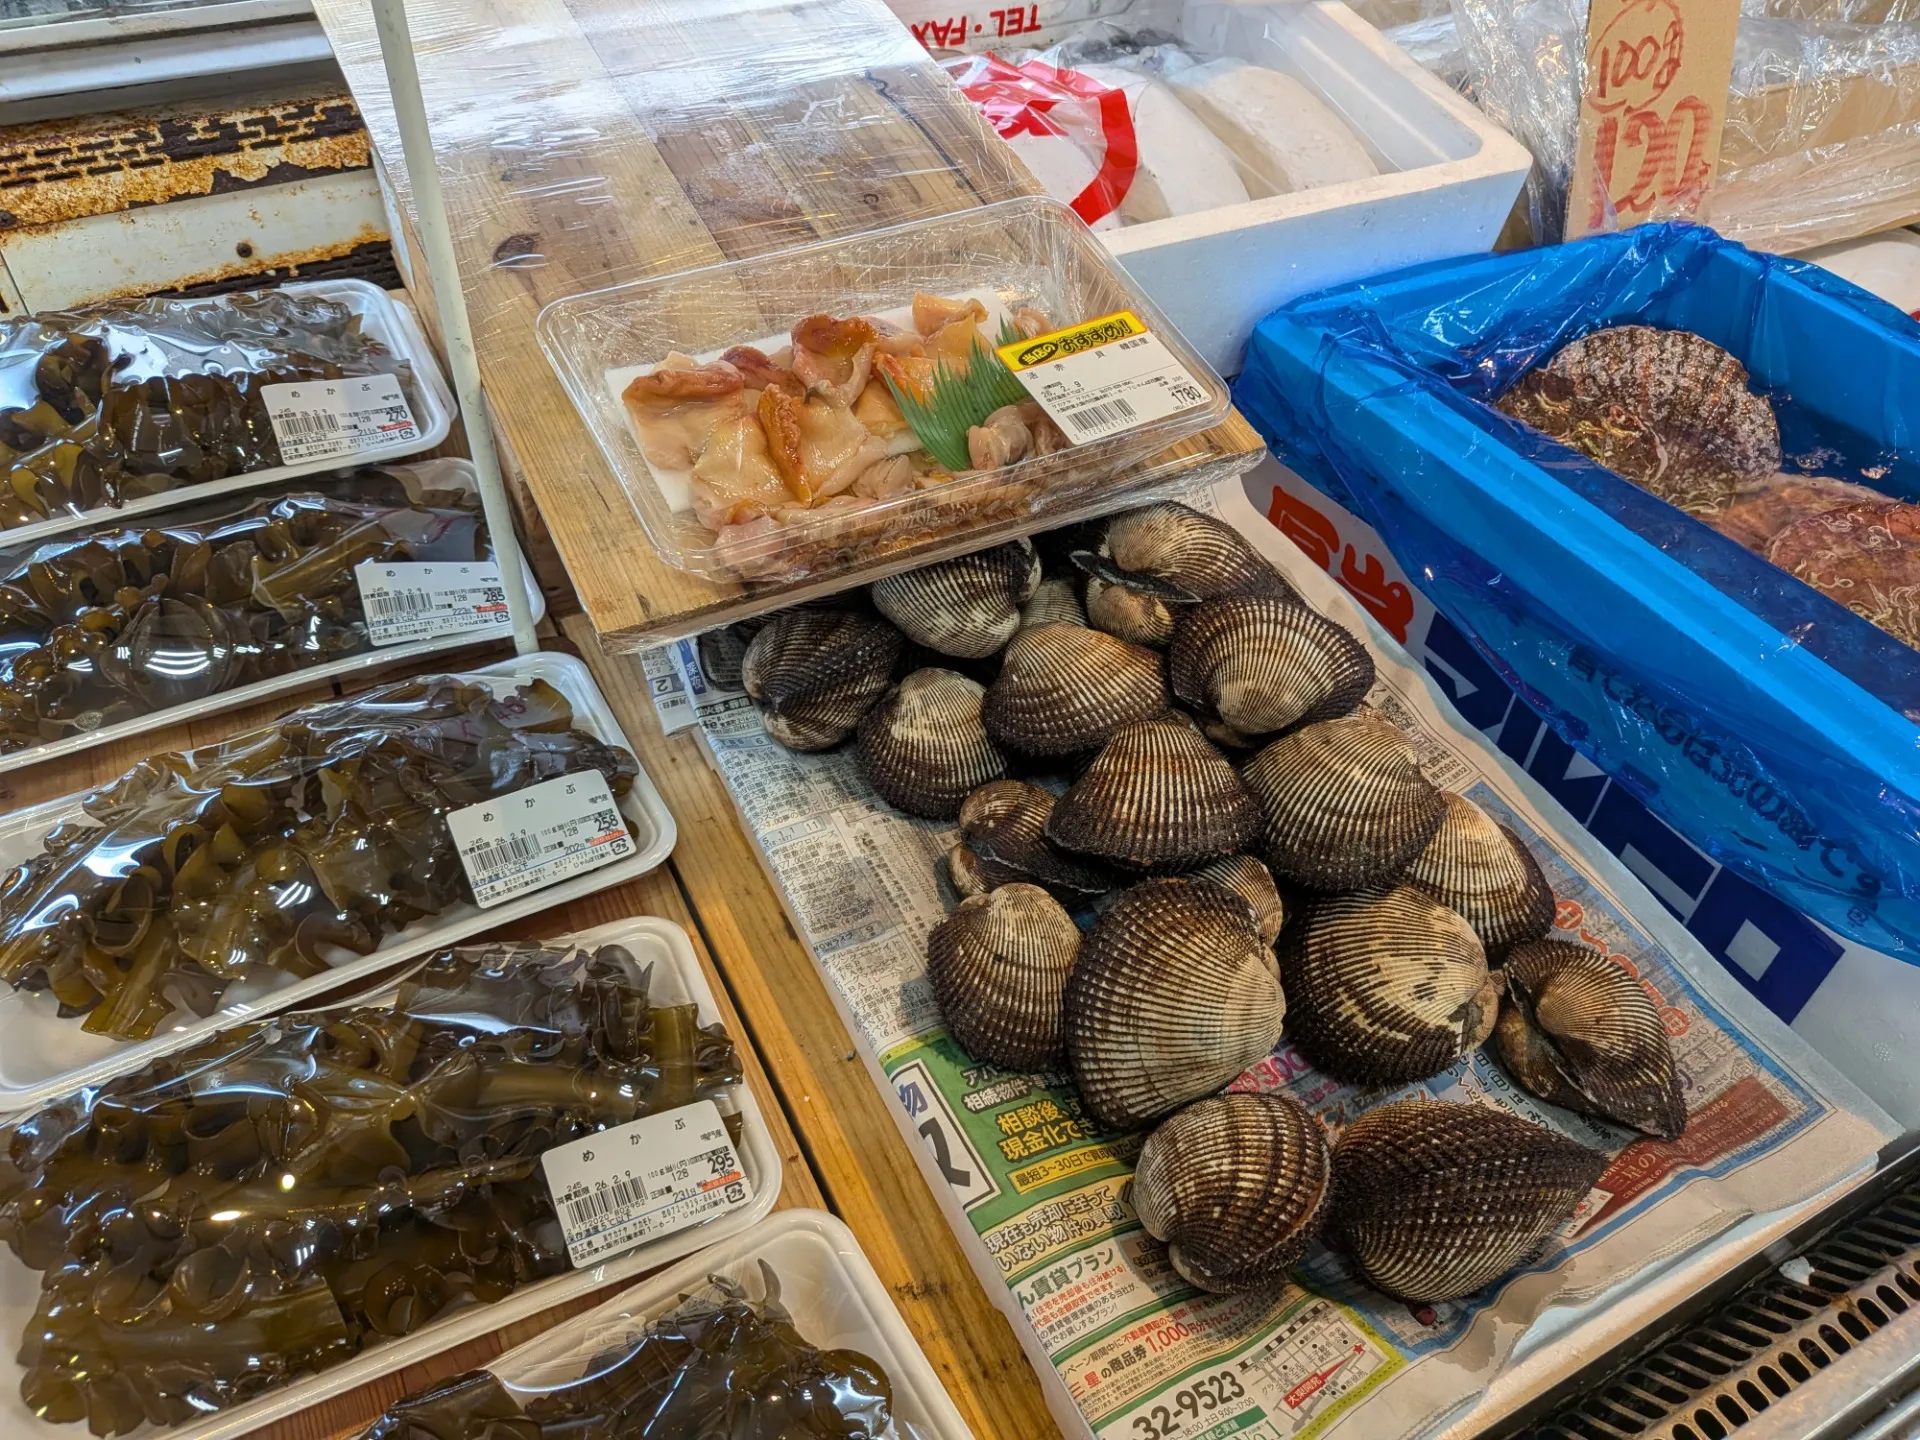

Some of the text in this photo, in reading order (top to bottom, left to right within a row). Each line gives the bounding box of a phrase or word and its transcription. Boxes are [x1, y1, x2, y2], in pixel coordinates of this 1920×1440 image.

[1021, 343, 1056, 364] 当店の
[1171, 387, 1201, 404] 1780
[386, 410, 408, 421] 270
[484, 592, 505, 602] 285
[686, 662, 703, 689] 深夜
[655, 679, 668, 692] 2
[755, 736, 763, 745] 6
[594, 814, 619, 832] 258
[807, 821, 818, 831] 11
[563, 827, 579, 838] 128
[495, 837, 508, 846] 26.
[707, 1153, 735, 1174] 295
[671, 1170, 689, 1181] 128
[556, 1186, 590, 1205] 消費期限
[595, 1181, 609, 1191] 26.
[625, 1170, 631, 1179] 9
[566, 1181, 582, 1192] 245
[650, 1186, 673, 1199] 正味量
[673, 1187, 696, 1203] 231g
[577, 1214, 609, 1231] 172020
[614, 1199, 646, 1217] 802952
[996, 1205, 1126, 1273] いない物件の買取
[571, 1240, 594, 1255] 加工者
[1288, 1376, 1321, 1405] 大東開発
[1132, 1371, 1245, 1440] 32-9523
[1204, 1412, 1220, 1426] 土日
